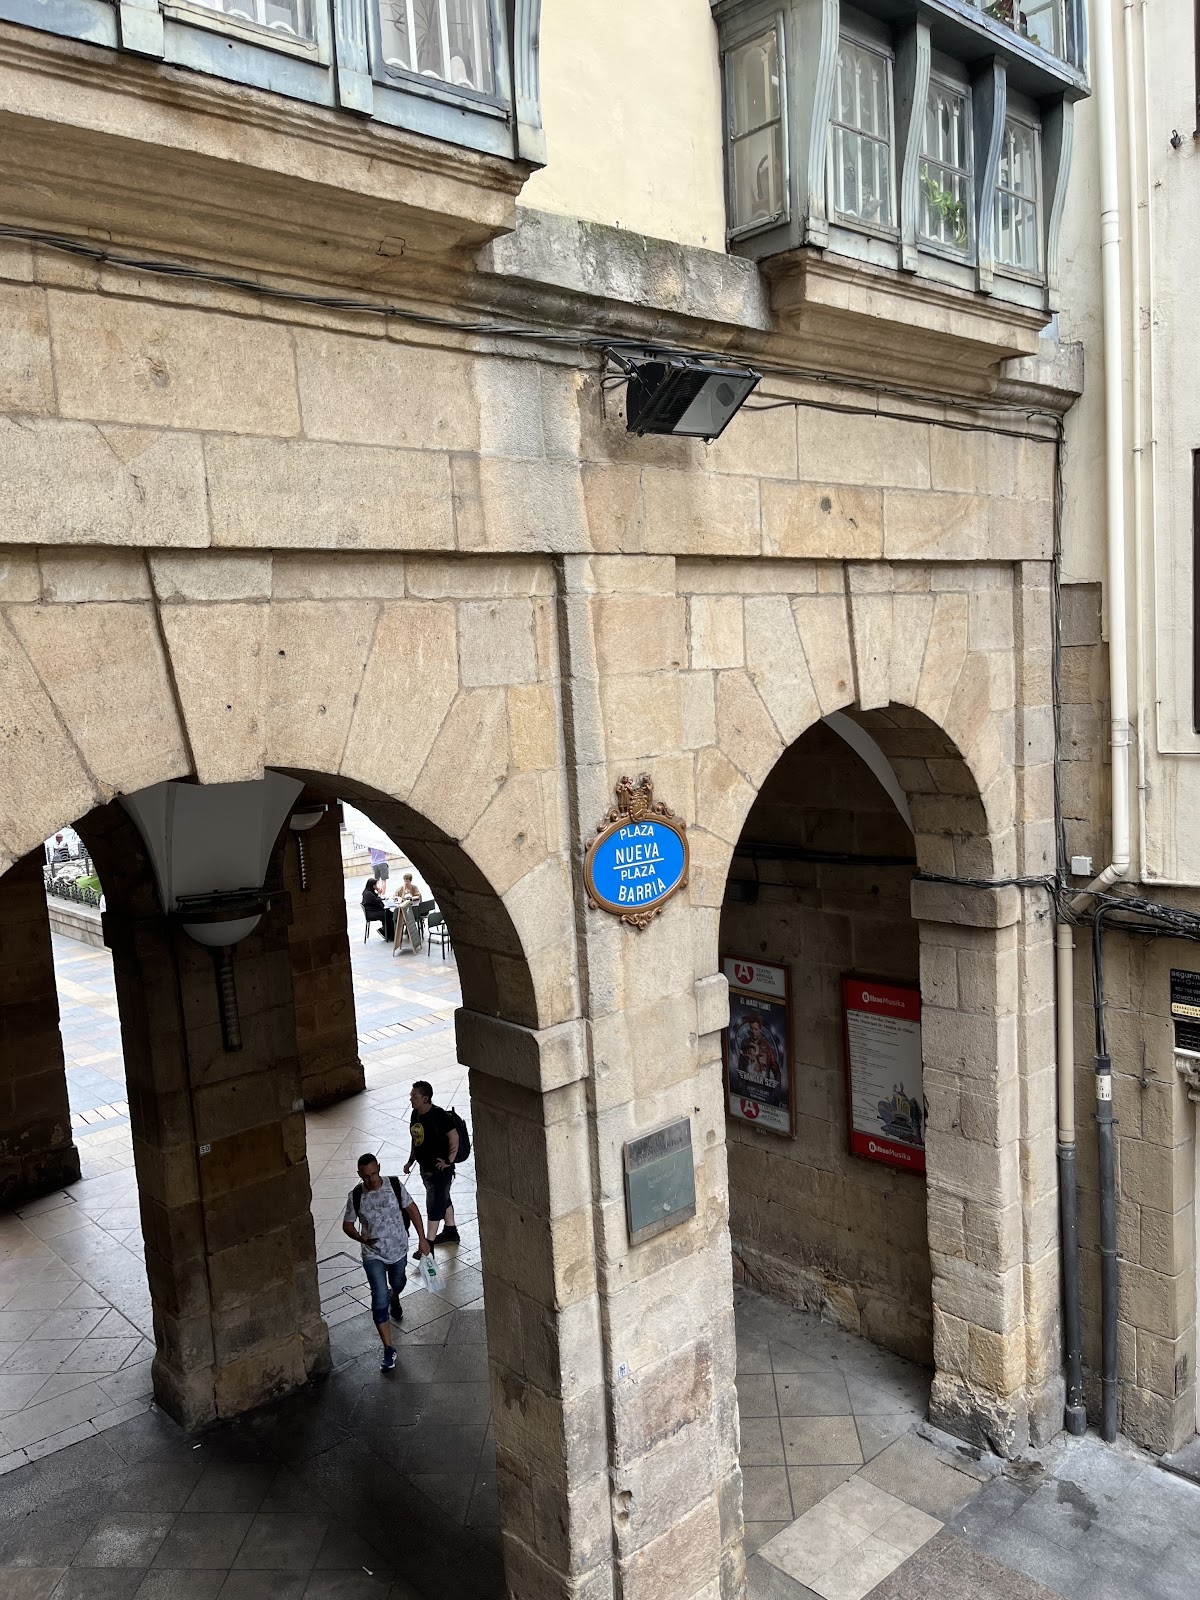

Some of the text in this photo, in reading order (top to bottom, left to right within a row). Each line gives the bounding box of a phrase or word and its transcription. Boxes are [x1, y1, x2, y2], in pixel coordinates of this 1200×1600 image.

[619, 825, 654, 840] PLAZA
[615, 842, 660, 865] NUEVA
[620, 864, 656, 881] PLAZA
[618, 877, 667, 903] BARRIA
